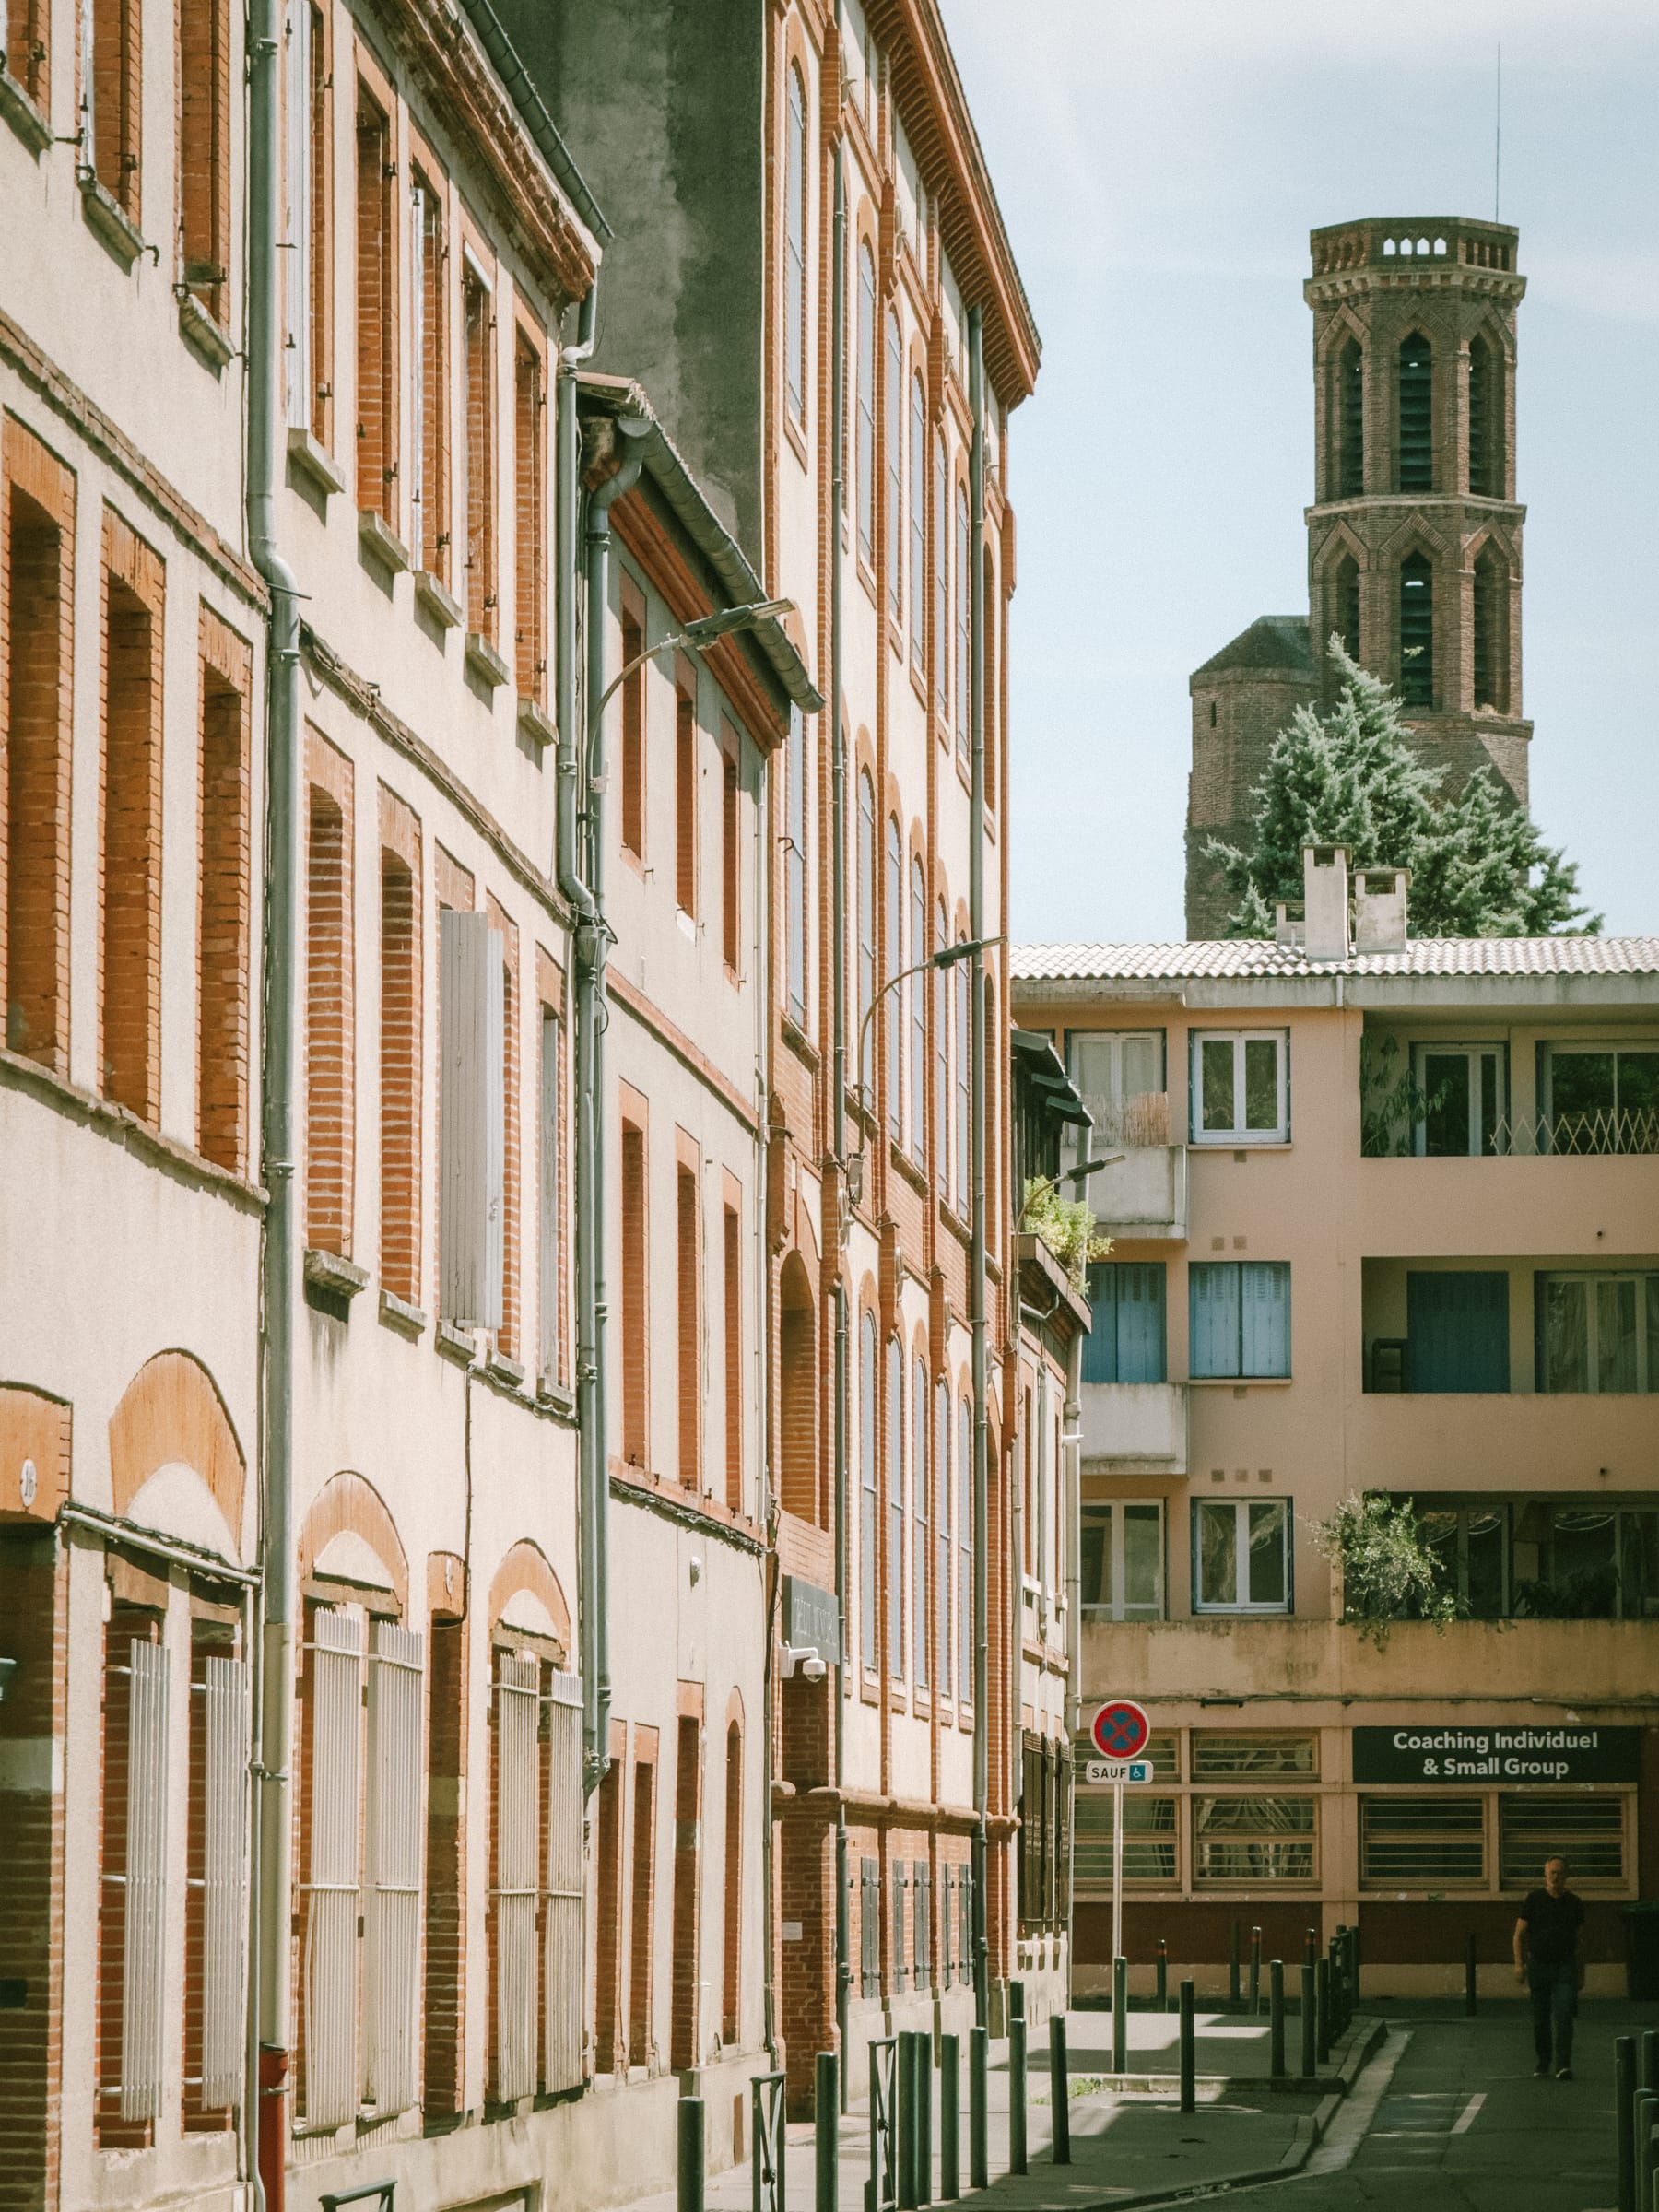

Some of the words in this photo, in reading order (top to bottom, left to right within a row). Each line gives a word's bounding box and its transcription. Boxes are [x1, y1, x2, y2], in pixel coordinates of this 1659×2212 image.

[1393, 1731, 1489, 1754] Coaching
[1494, 1731, 1598, 1749] Individuel
[1091, 1767, 1127, 1779] SAUF
[1422, 1758, 1439, 1775] &
[1443, 1757, 1500, 1775] Small
[1504, 1758, 1569, 1780] Group
